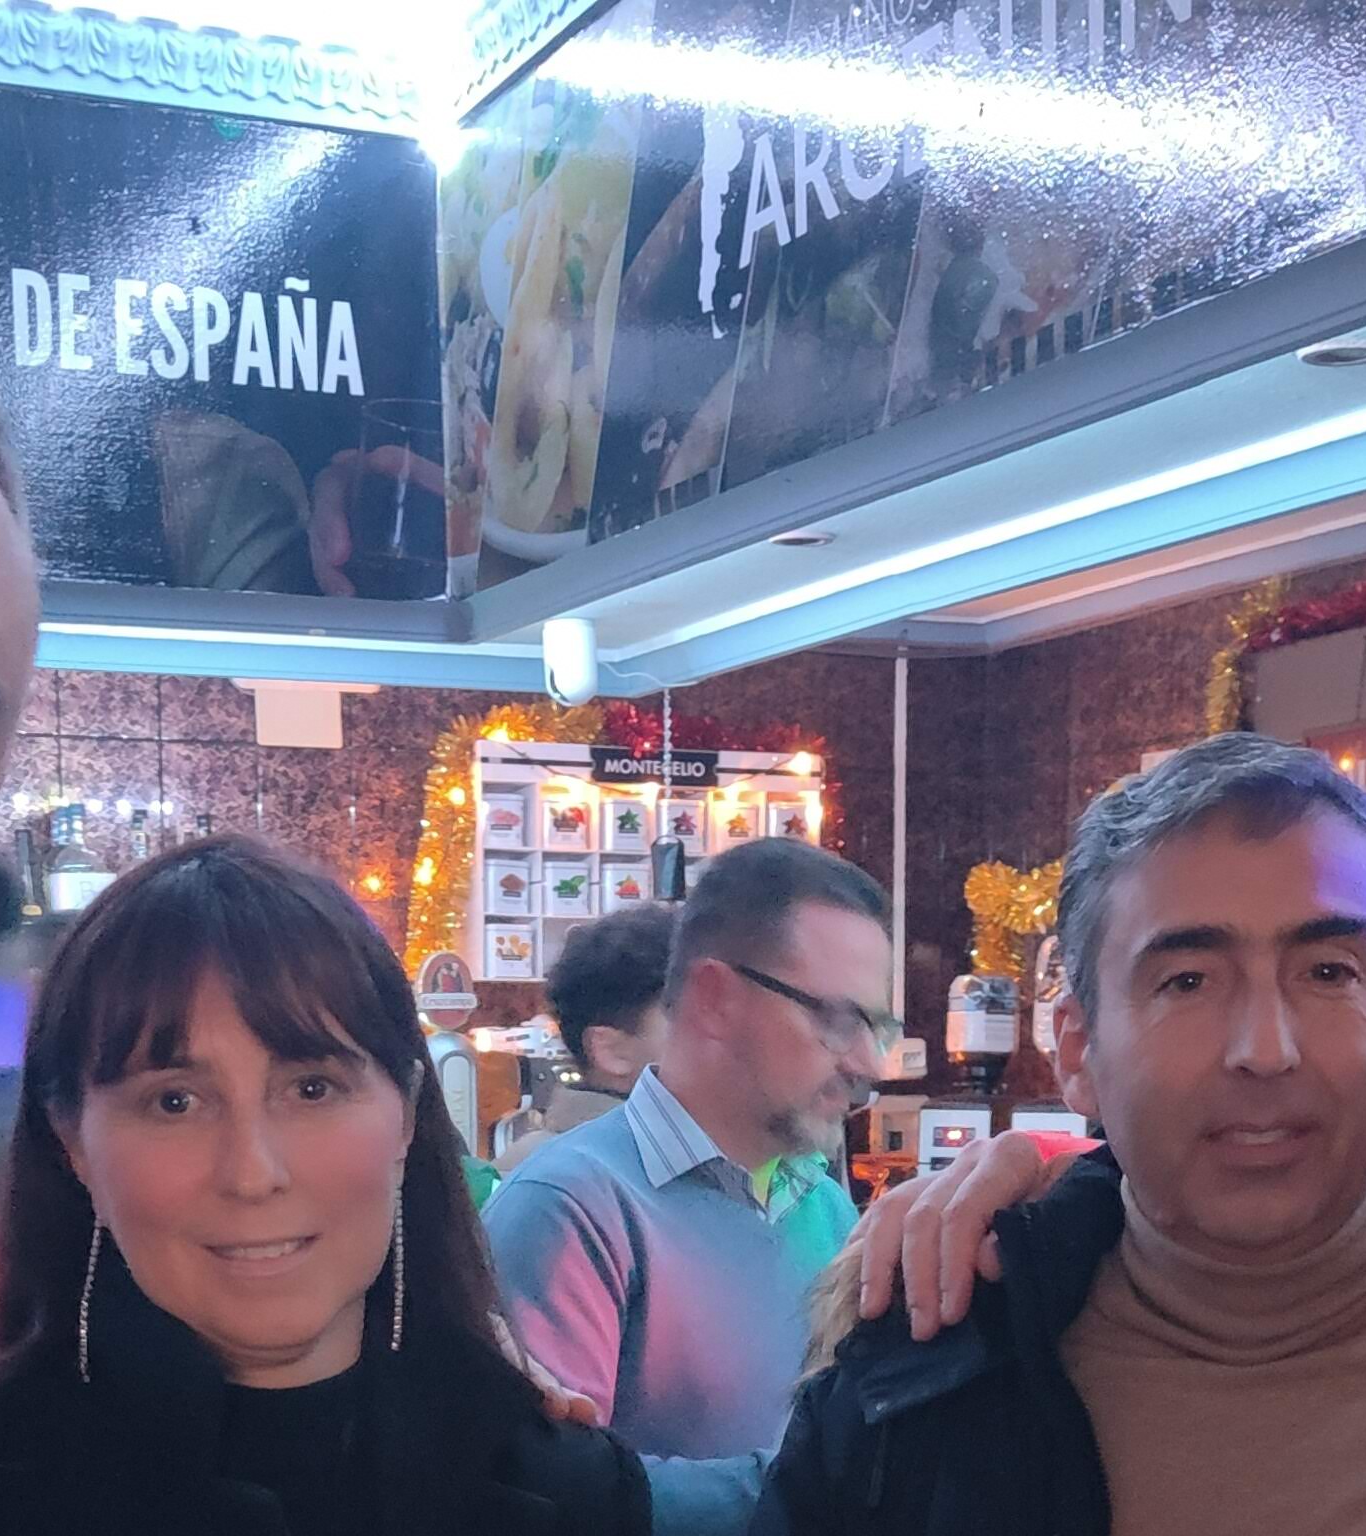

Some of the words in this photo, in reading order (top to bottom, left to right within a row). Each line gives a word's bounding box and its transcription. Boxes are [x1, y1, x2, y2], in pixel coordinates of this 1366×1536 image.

[12, 268, 92, 371] DE
[115, 277, 365, 396] ESPAÑA
[604, 758, 706, 777] MONTEELIO
